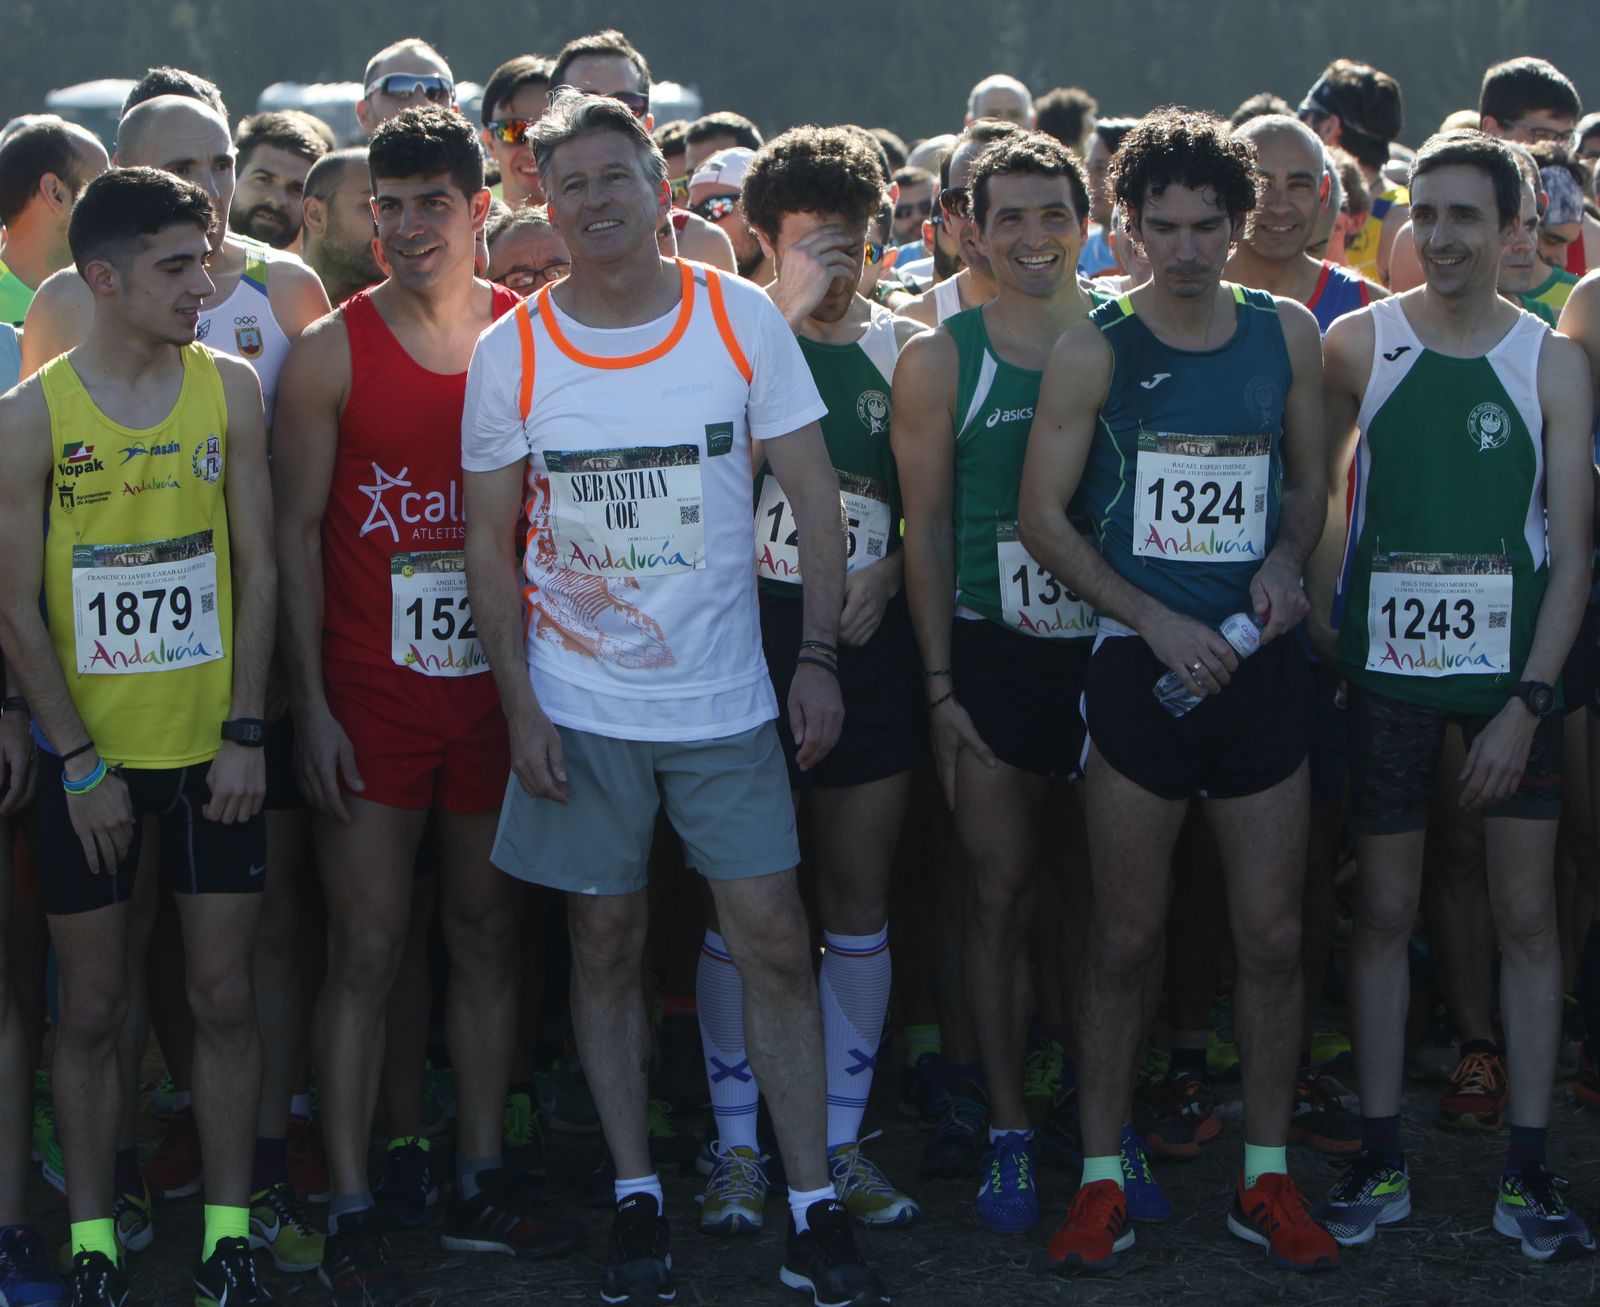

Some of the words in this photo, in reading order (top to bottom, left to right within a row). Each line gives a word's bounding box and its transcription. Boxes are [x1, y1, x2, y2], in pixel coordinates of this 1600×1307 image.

[57, 458, 105, 478] Vopak
[122, 474, 182, 497] Andalucía
[570, 469, 669, 503] SEBASTIAN
[1148, 478, 1245, 524] 1324
[604, 500, 640, 531] COE
[568, 540, 692, 571] Andalucía
[1143, 523, 1257, 556] Andalucía
[87, 574, 127, 582] FRANCISCO
[128, 573, 151, 581] JAVIER
[88, 585, 192, 636] 1879
[406, 597, 478, 640] 152
[1381, 596, 1476, 640] 1243
[88, 631, 212, 669] Andalucía
[1380, 641, 1496, 671] Andalucía
